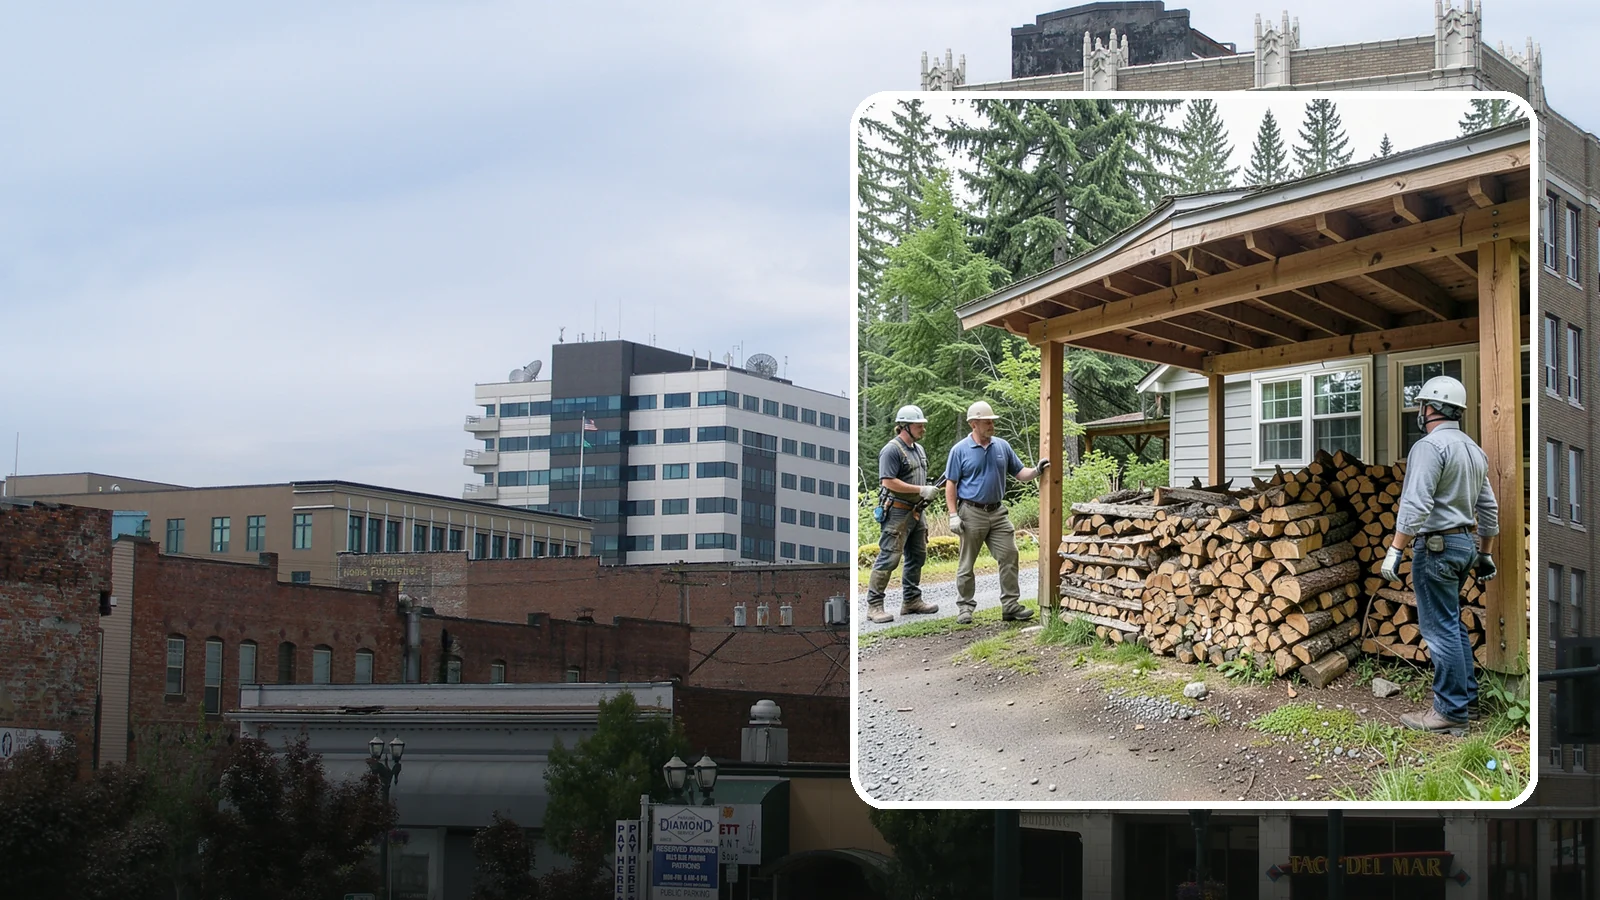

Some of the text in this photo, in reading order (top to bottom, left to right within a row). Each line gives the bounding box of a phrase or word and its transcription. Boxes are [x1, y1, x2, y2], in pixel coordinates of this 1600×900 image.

[343, 566, 427, 577] Home Furnishers
[660, 818, 713, 833] DIAMOND
[1022, 814, 1070, 828] BUILDING
[719, 824, 740, 835] ETT
[656, 845, 716, 854] RESERVED PARKING
[719, 839, 740, 849] ANT
[616, 825, 625, 894] PAY HERE
[627, 824, 637, 894] PAY HERE
[671, 862, 701, 870] PATRONS
[1289, 855, 1442, 876] TAC DEL MAR
[660, 889, 710, 898] PUBLIC PARKING
